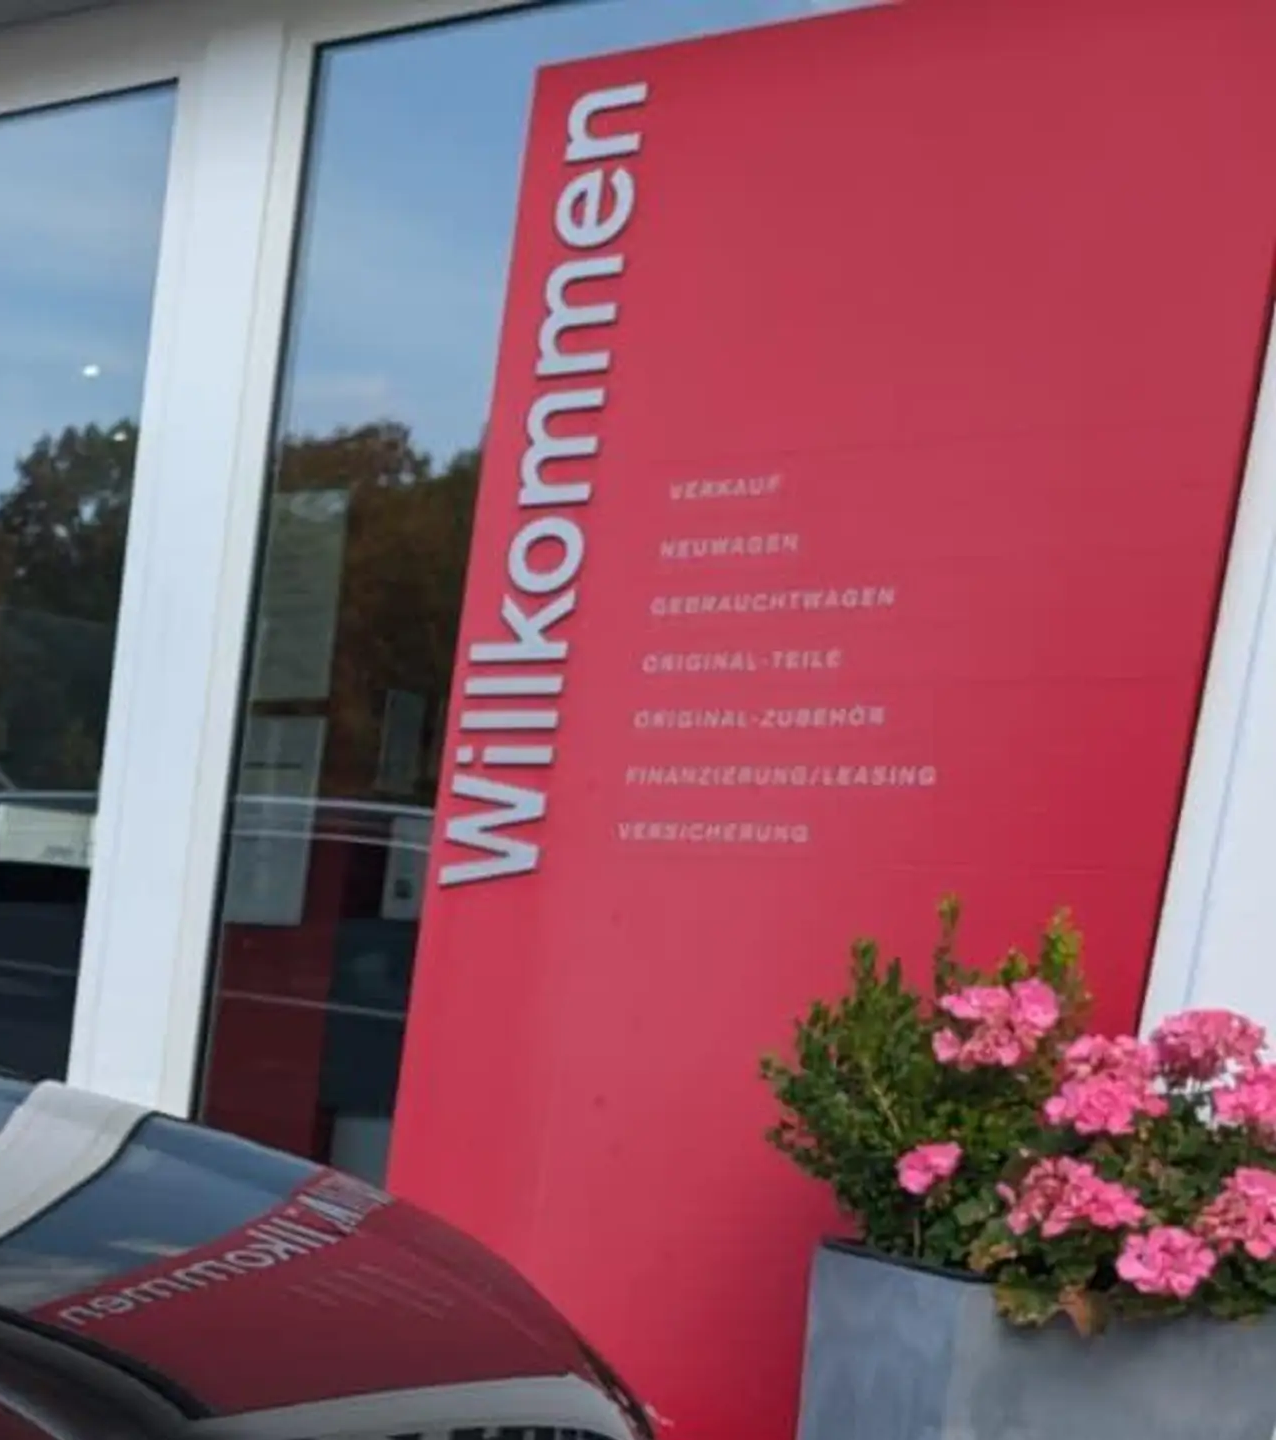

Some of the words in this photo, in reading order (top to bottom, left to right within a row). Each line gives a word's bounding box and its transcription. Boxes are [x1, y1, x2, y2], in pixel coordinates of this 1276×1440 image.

[437, 80, 649, 888] Willkommen
[669, 474, 782, 500] VERKAUF
[660, 533, 799, 559] NEUWAGEN
[650, 587, 896, 616] GEBRAUCHTWAGEN
[625, 765, 938, 787] FINANZIERUNG/LEASING
[618, 823, 810, 844] VERSICHERUNG
